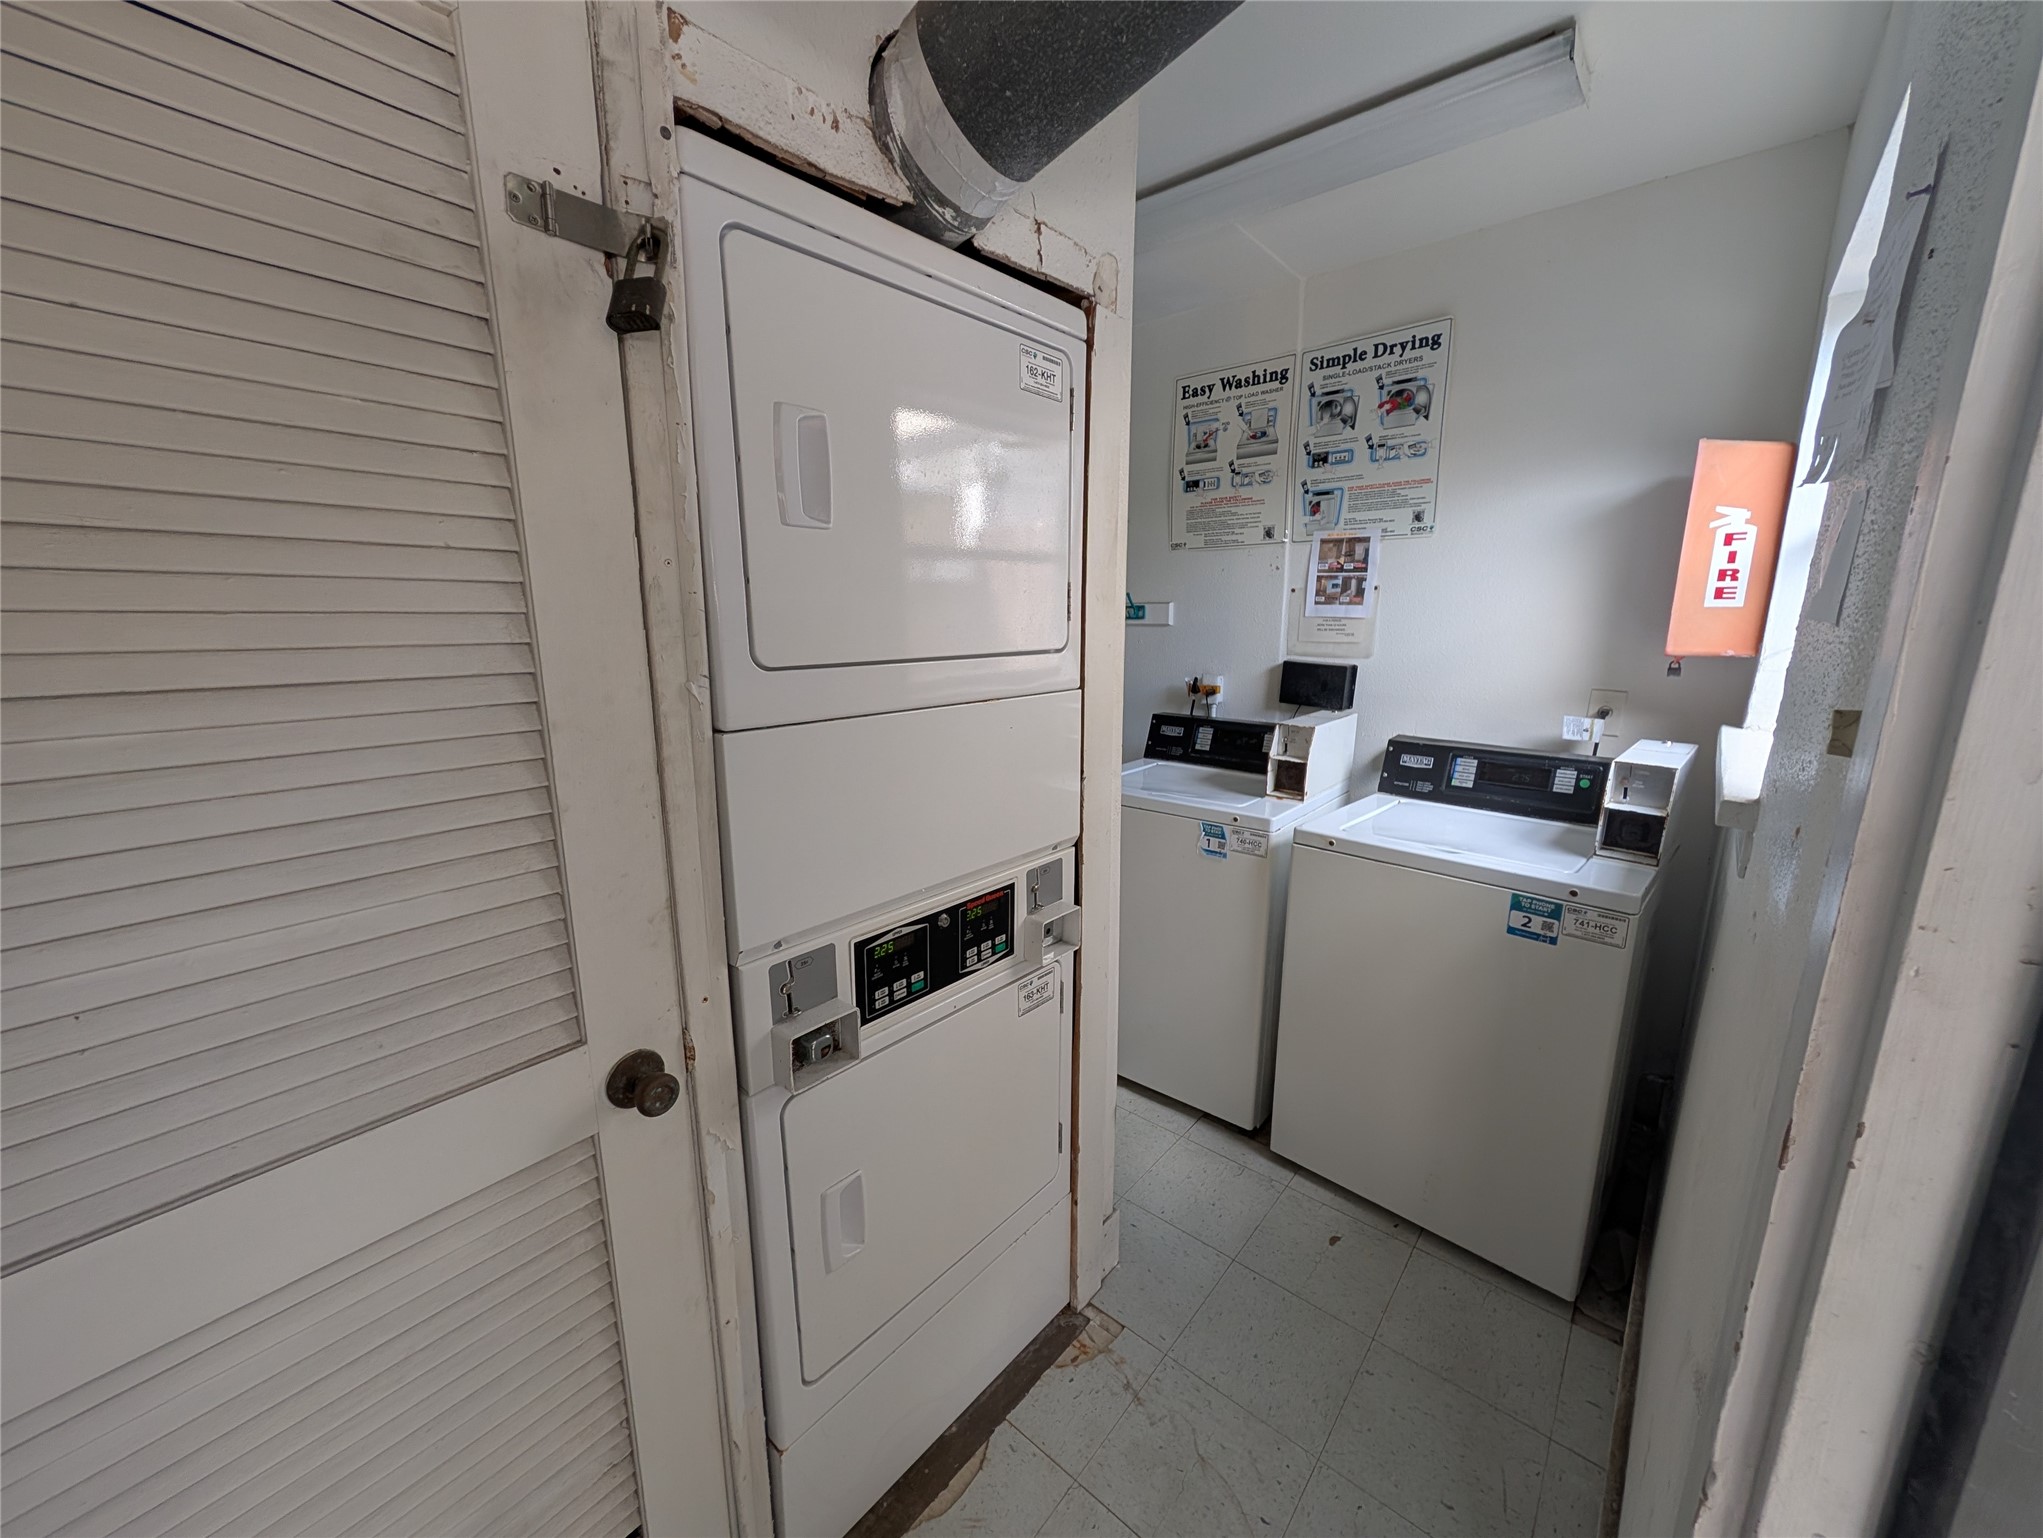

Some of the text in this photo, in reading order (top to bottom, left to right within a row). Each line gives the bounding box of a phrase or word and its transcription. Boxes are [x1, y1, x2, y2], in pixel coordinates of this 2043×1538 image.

[1309, 347, 1367, 372] Simple
[1372, 333, 1443, 359] Drying
[1026, 365, 1056, 384] 162-KHT
[1322, 361, 1392, 381] SINGLE-LOAD/STACK
[1394, 355, 1424, 369] DRYERS
[1181, 383, 1216, 401] Easy
[1219, 367, 1290, 393] Washing
[1182, 398, 1225, 410] HIGH-EFFICIENCY
[1244, 391, 1260, 399] LOAD
[1260, 386, 1284, 396] WASHER
[1410, 525, 1429, 533] CSC
[1713, 532, 1748, 600] FIRE
[1205, 838, 1211, 849] 1
[1519, 896, 1556, 909] TAP PHONE
[1531, 904, 1552, 913] START
[1520, 914, 1533, 929] 2
[1573, 918, 1618, 935] 741-HCC
[874, 941, 894, 959] 2.25
[1022, 982, 1050, 1002] 163-KHT
